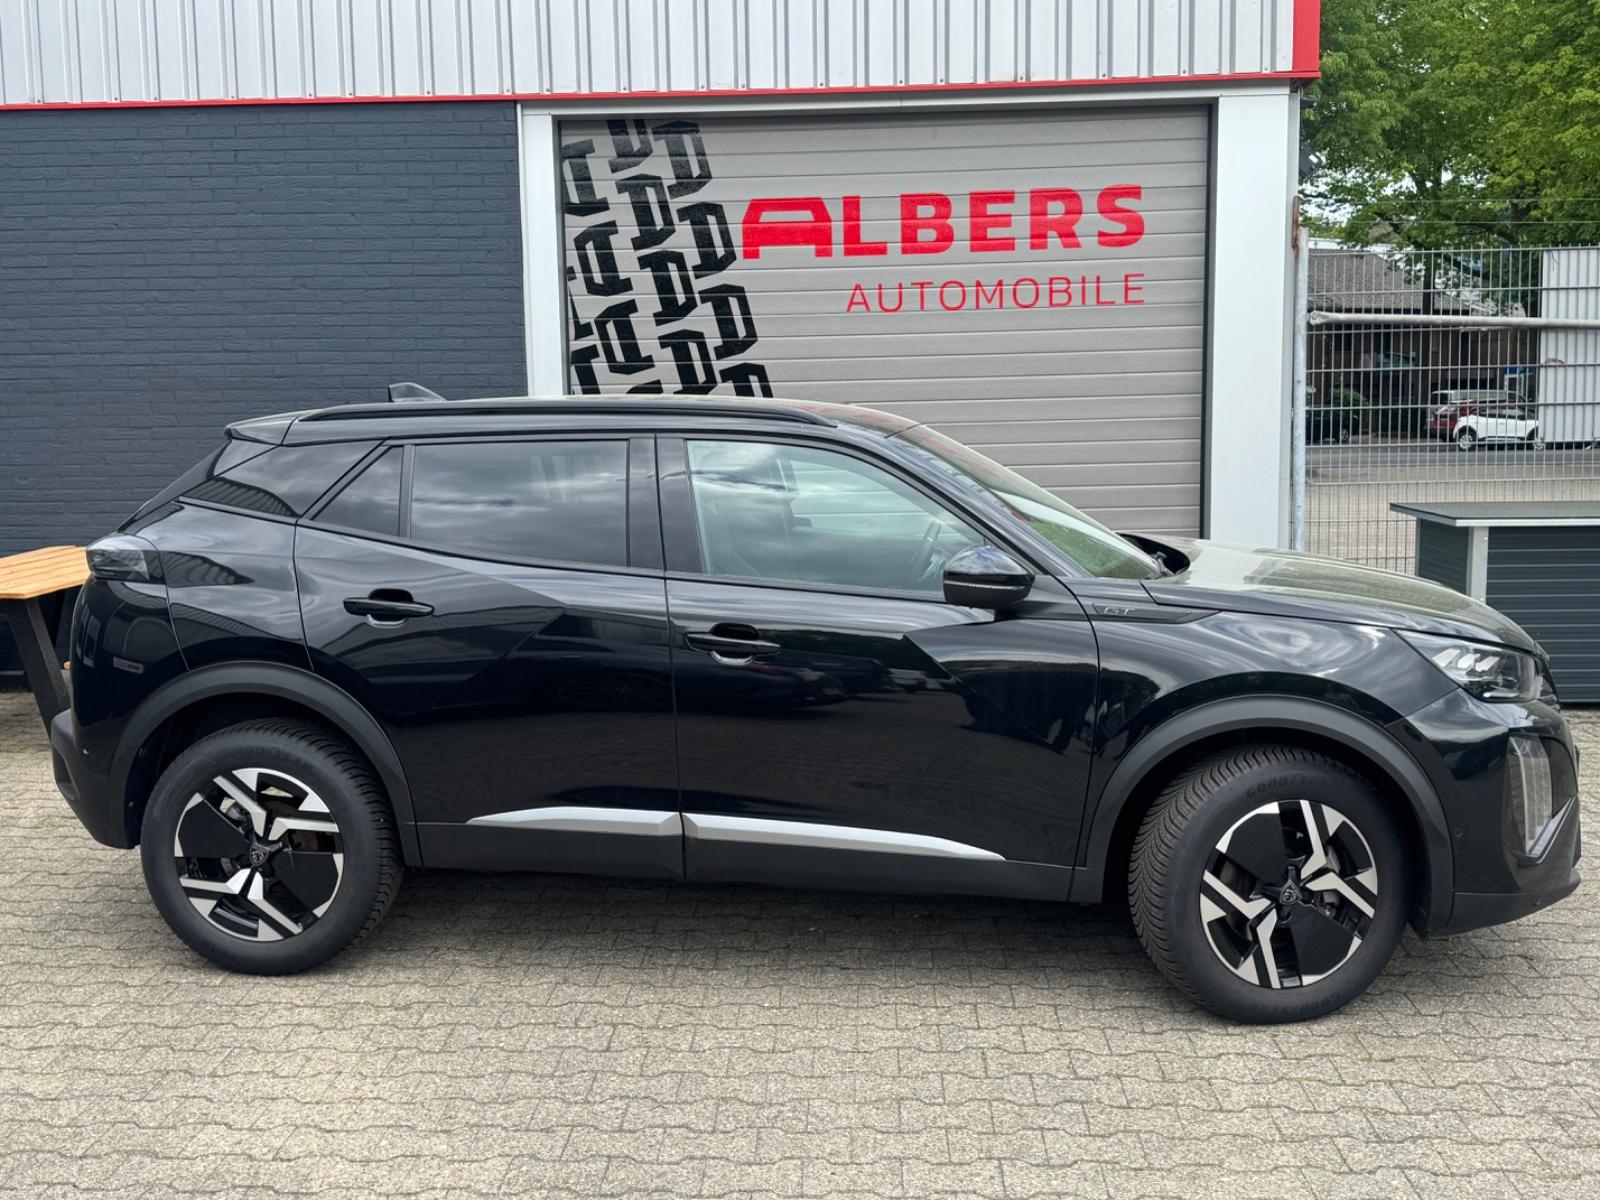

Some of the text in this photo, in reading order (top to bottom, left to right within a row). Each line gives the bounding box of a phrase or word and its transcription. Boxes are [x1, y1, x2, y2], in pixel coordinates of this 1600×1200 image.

[741, 184, 1146, 260] ALBERS
[846, 273, 1145, 314] AUTOMOBILE
[1103, 606, 1136, 616] GT
